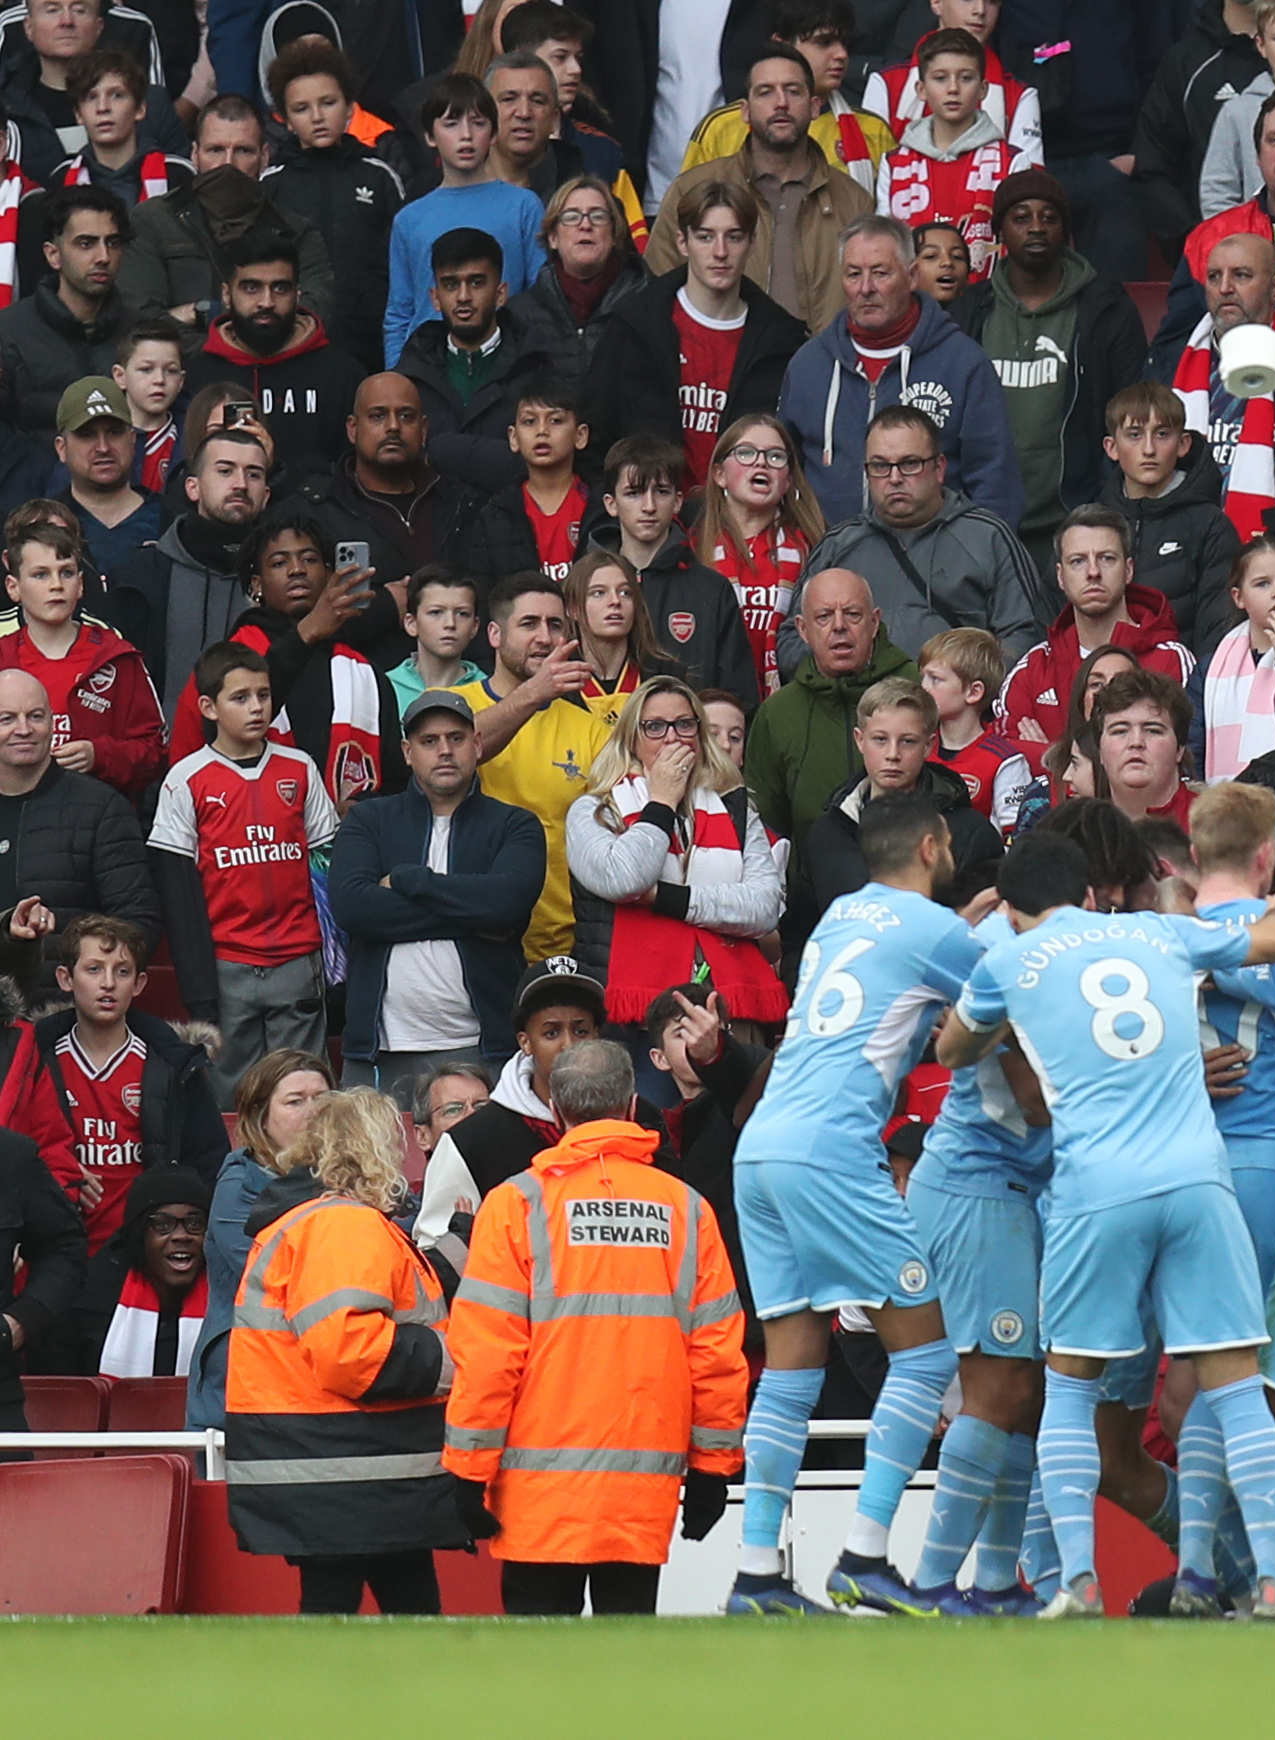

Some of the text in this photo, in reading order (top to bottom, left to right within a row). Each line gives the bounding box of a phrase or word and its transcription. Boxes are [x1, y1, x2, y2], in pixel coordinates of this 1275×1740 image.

[245, 824, 275, 842] Fly
[214, 841, 303, 869] Emirates
[823, 901, 903, 933] AHREZ
[1079, 956, 1166, 1061] 8
[83, 1117, 116, 1141] Fly
[571, 1200, 670, 1223] ARSENAL
[570, 1225, 670, 1247] STEWARD
